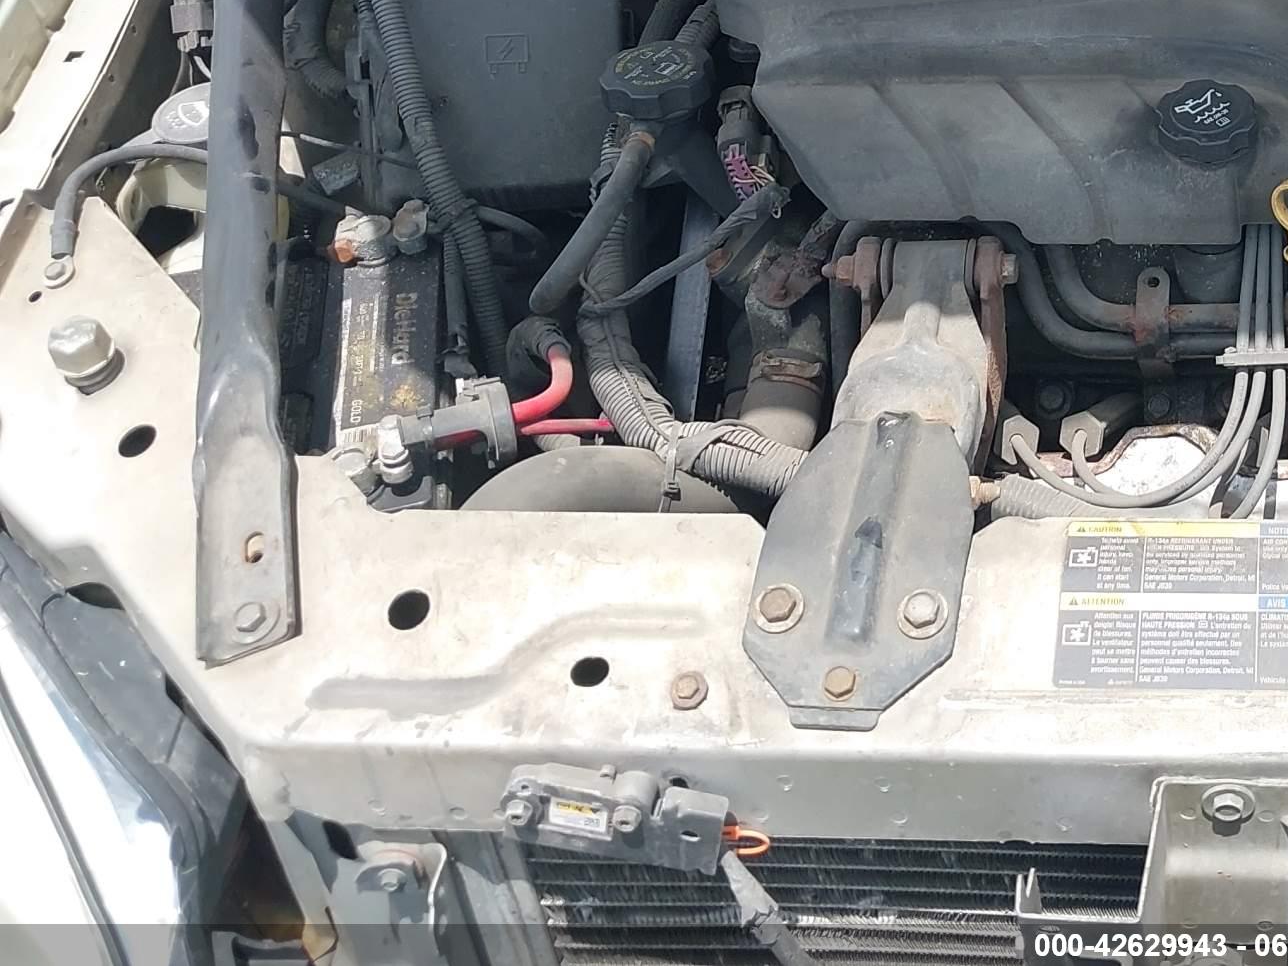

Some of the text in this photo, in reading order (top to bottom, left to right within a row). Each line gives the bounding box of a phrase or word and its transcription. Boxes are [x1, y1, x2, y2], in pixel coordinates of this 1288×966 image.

[391, 292, 418, 365] DieHard
[350, 399, 363, 424] GOLD
[1266, 598, 1286, 608] AVIS
